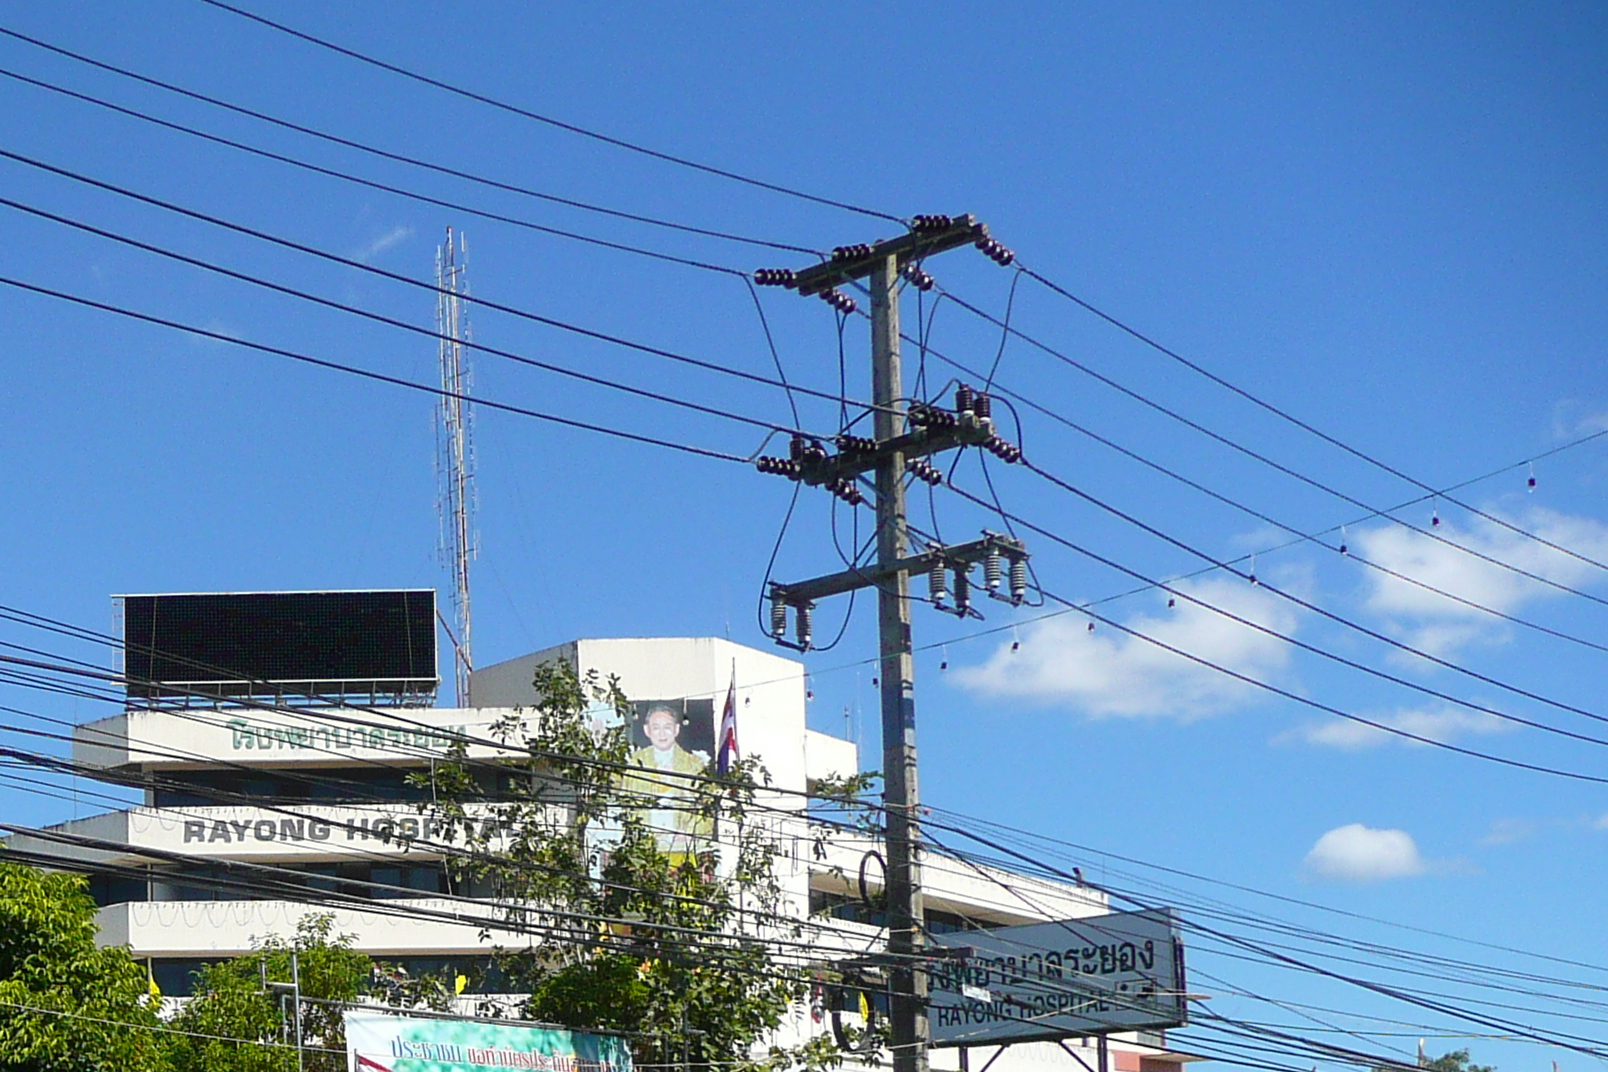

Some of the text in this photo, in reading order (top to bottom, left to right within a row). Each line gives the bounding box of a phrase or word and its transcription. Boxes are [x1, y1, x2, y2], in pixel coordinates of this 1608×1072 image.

[183, 816, 331, 844] RAYONG
[937, 989, 1110, 1028] RAYONG HOSPITAL
[391, 1035, 462, 1062] ประชาชน
